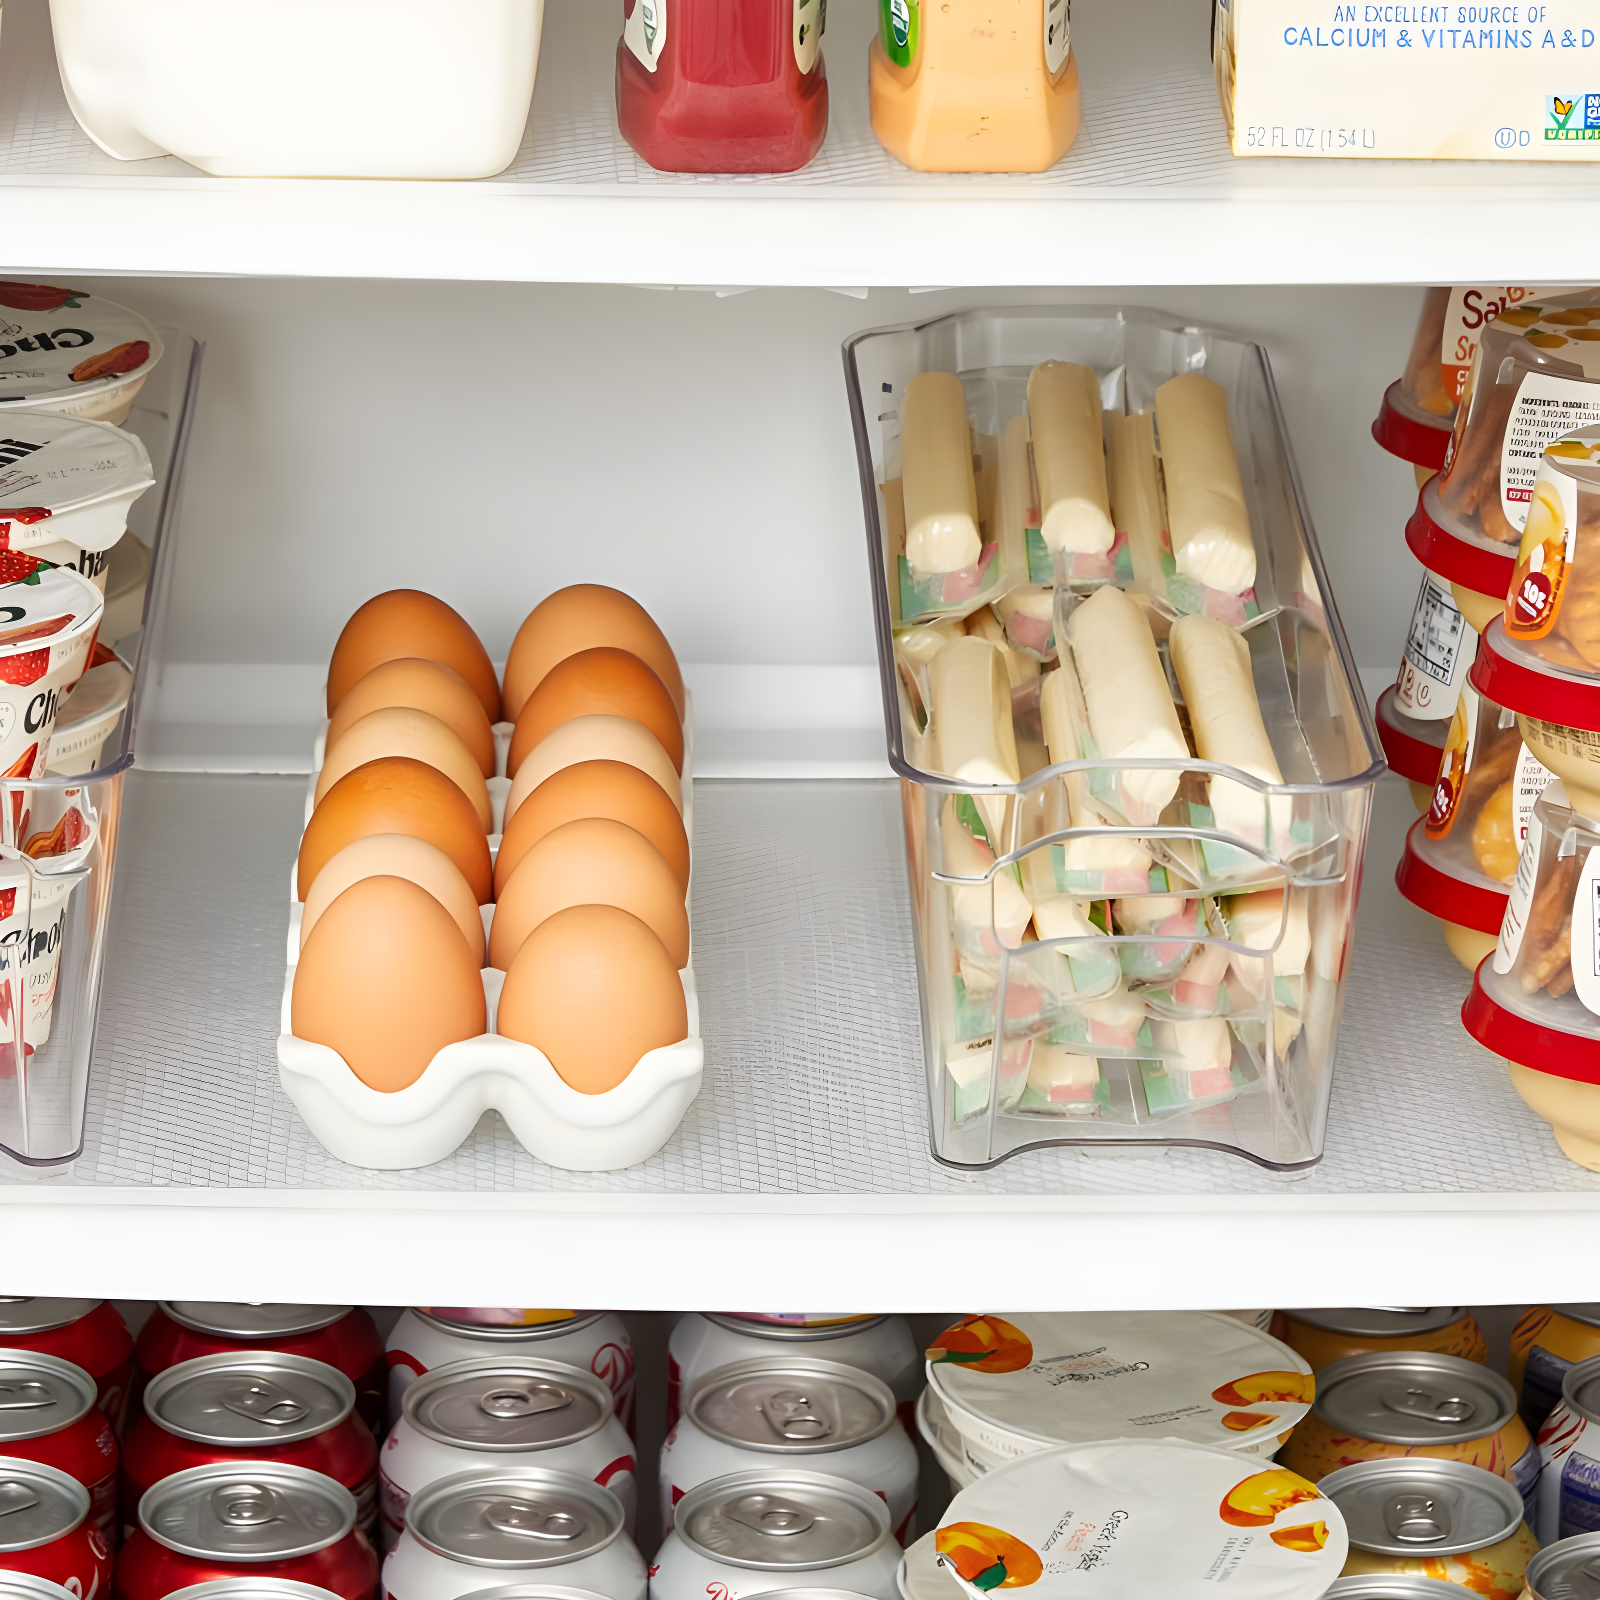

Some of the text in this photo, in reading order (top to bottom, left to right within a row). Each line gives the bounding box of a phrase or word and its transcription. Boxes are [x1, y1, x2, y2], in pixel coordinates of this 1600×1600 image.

[1333, 5, 1548, 24] AN EXCELLENT SOURCE OF
[1283, 26, 1386, 48] CALCIUM
[1396, 29, 1413, 48] &
[1421, 28, 1533, 49] VITAMINS
[1247, 126, 1266, 147] 52
[1271, 126, 1289, 147] FL
[1295, 127, 1315, 148] OZ
